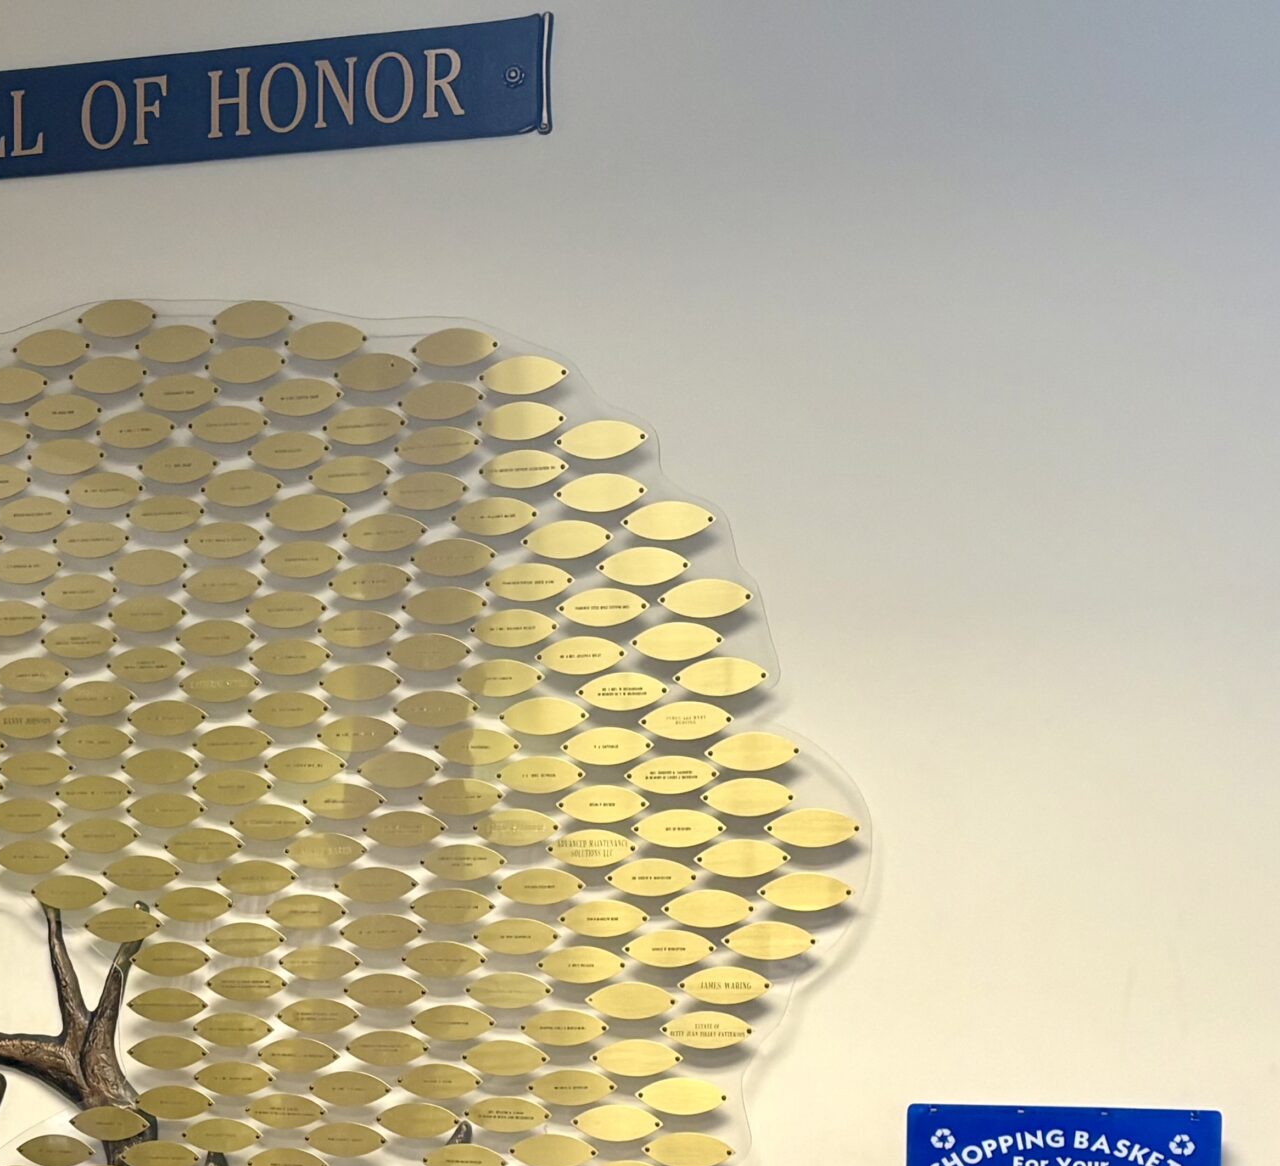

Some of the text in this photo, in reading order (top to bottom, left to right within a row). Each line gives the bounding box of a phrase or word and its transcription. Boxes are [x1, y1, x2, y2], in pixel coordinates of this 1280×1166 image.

[81, 75, 168, 151] OF
[207, 47, 465, 139] HONOR
[557, 839, 628, 848] ADVANCED MAINTENANCE
[570, 848, 613, 858] SOLUTIONS LLC
[700, 981, 752, 990] JAMES WARING
